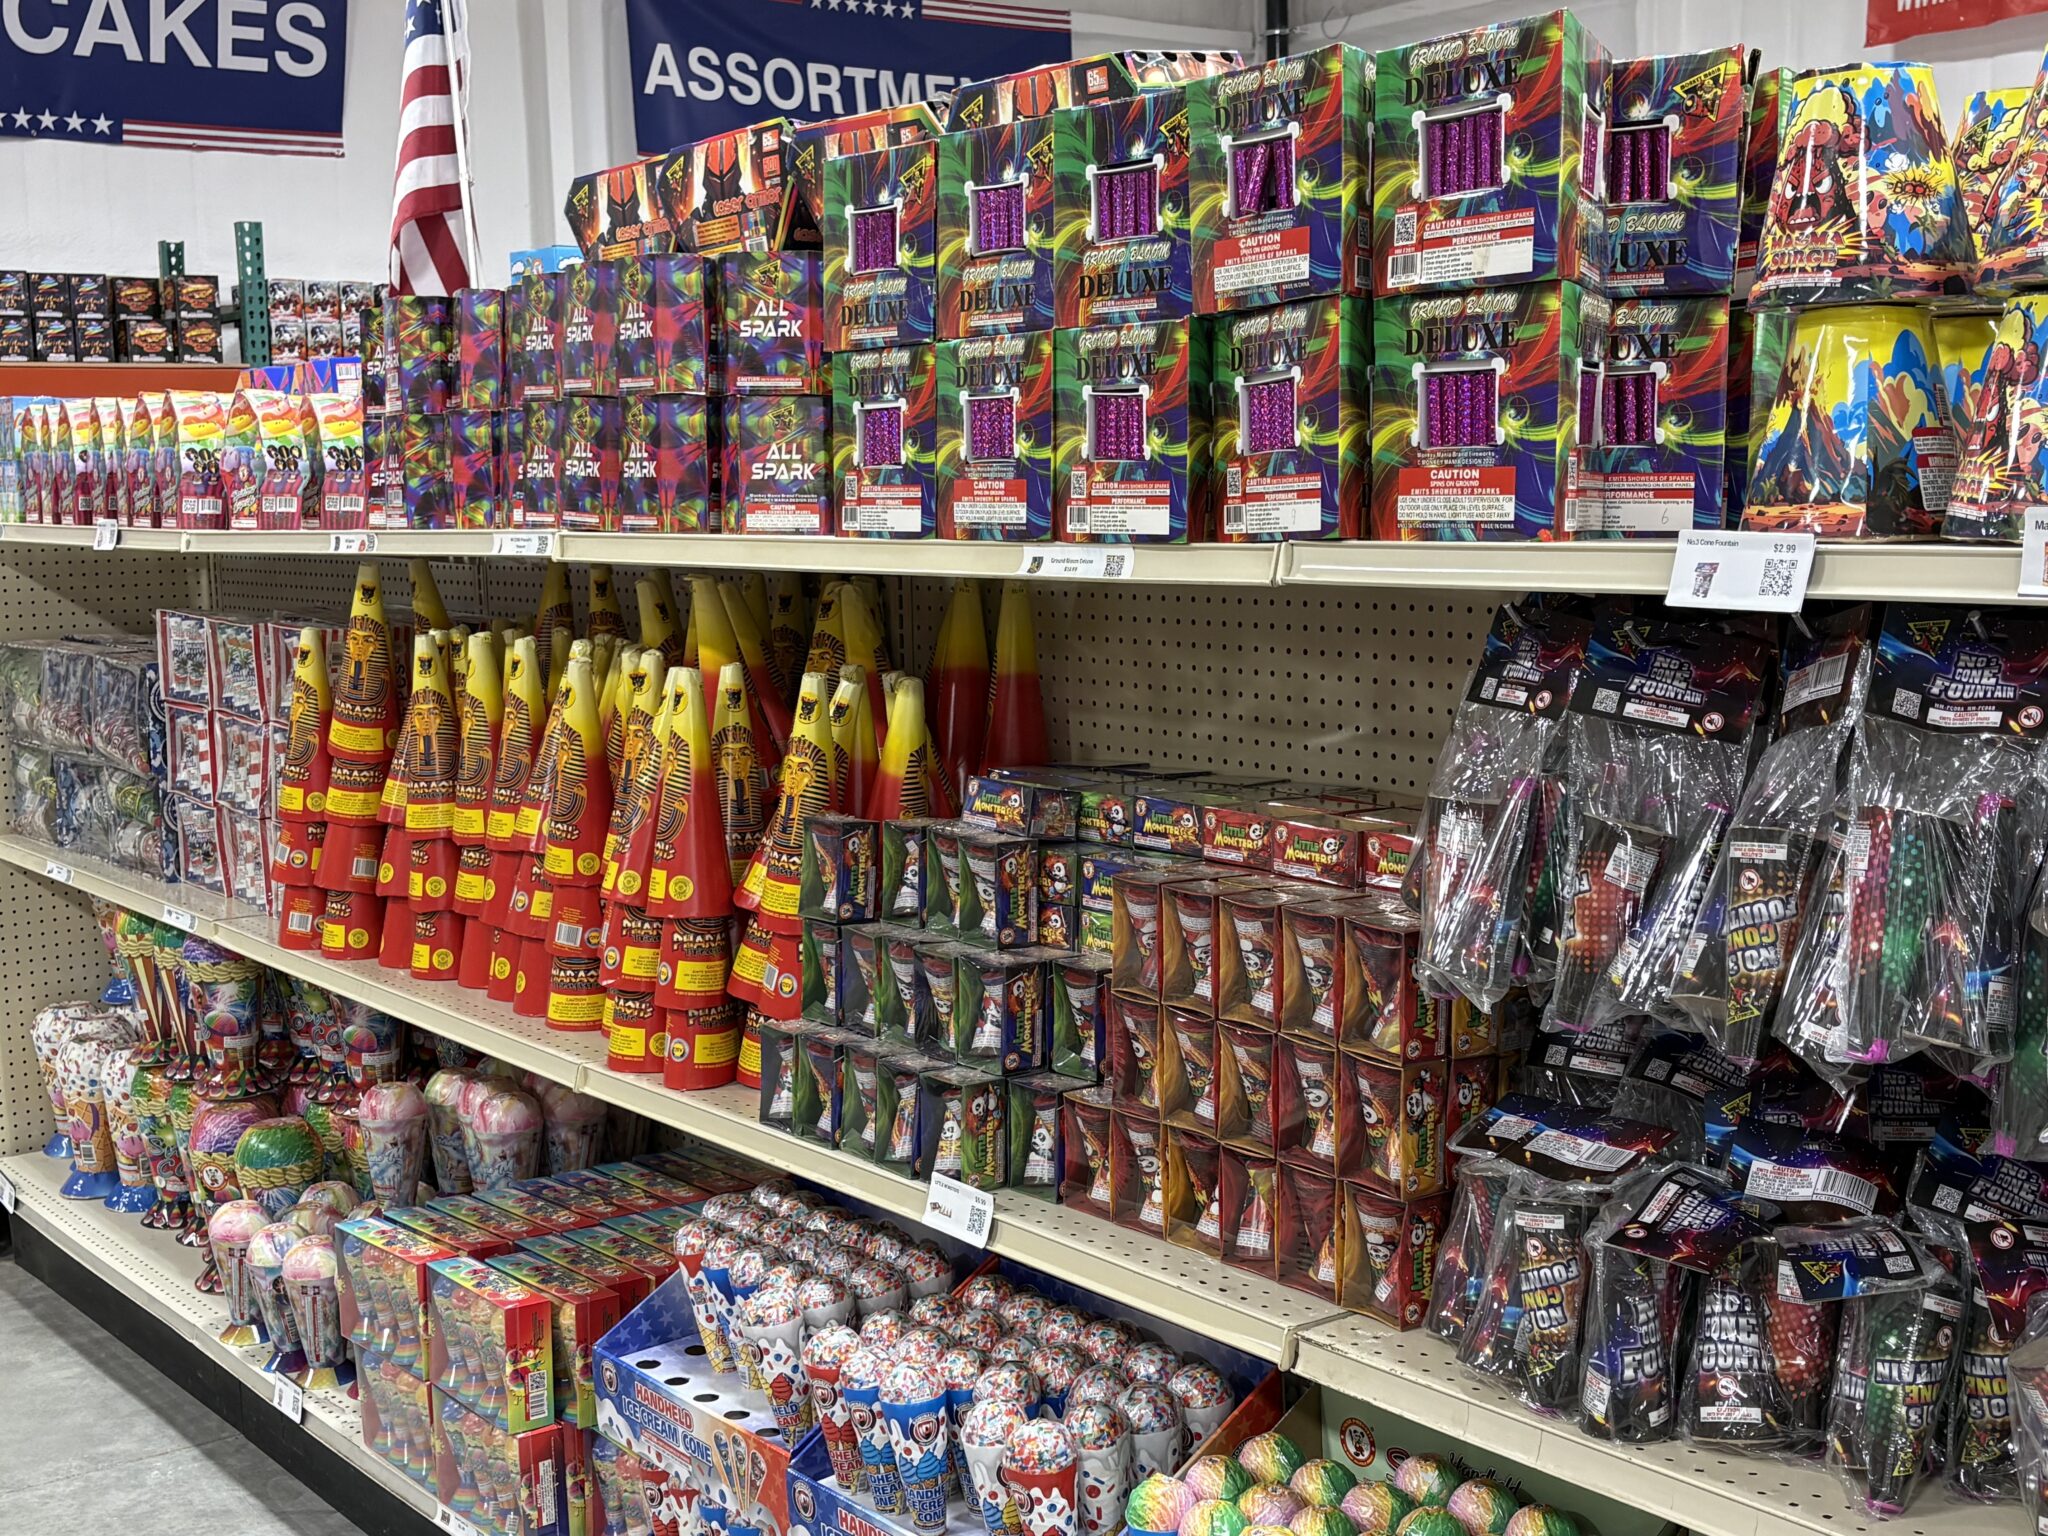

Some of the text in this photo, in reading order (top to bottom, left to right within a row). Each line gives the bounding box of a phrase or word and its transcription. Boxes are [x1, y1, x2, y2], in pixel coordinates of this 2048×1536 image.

[2, 0, 329, 79] CAKES
[1410, 29, 1520, 74] GROUND BLOOM
[1217, 59, 1305, 101] GROUND BLOOM
[1404, 56, 1522, 107] DELUXE
[1215, 87, 1309, 131] DELUXE
[1424, 218, 1462, 232] CAUTION
[1512, 210, 1534, 219] SPARKS
[1626, 211, 1686, 233] BLOOM
[1239, 232, 1281, 249] CAUTION
[1452, 231, 1501, 246] PERFORMANCE
[1770, 249, 1838, 269] SURGE
[1079, 266, 1172, 299] DELUXE
[754, 299, 790, 317] ALL
[959, 284, 1036, 313] DELUXE
[1410, 293, 1519, 322] GROUND BLOOM
[571, 307, 589, 323] ALL
[625, 301, 646, 320] ALL
[841, 301, 909, 326] DELUXE
[1615, 306, 1678, 326] BLOOM
[531, 315, 548, 333] ALL
[619, 319, 653, 341] SPARK
[739, 319, 802, 338] SPARK
[525, 332, 555, 352] SPARK
[566, 324, 594, 344] SPARK
[1404, 319, 1520, 358] DELUXE
[1230, 335, 1310, 373] DELUXE
[956, 361, 1029, 388] DELUXE
[1077, 352, 1160, 381] DELUXE
[849, 370, 913, 396] DELUXE
[532, 445, 549, 461] ALL
[572, 441, 593, 458] ALL
[630, 441, 649, 458] ALL
[766, 442, 803, 460] ALL
[526, 462, 555, 479] SPARK
[565, 460, 600, 478] SPARK
[623, 460, 657, 479] SPARK
[750, 462, 817, 480] SPARK
[1430, 469, 1480, 480] CAUTION
[973, 480, 1005, 490] CAUTION
[1091, 481, 1119, 489] CAUTION
[1246, 477, 1271, 486] CAUTION
[1429, 480, 1480, 488] SPINS ON GROUND
[1410, 488, 1430, 496] EMITS
[1431, 488, 1462, 496] SHOWERS
[1473, 487, 1501, 495] SPARKS
[1111, 497, 1147, 506] PERFORMANCE
[1661, 508, 1669, 526] 6
[1700, 539, 1715, 547] Cone
[1715, 539, 1740, 548] Fountain
[1773, 543, 1797, 554] $2.99
[1654, 653, 1681, 669] NO
[1957, 653, 1986, 669] NO
[1650, 668, 1691, 690] CONE
[1954, 667, 1999, 686] CONE
[1628, 676, 1704, 705] FOUNTAIN
[1930, 676, 2015, 701] FOUNTAIN
[1222, 821, 1246, 838] LITTLE
[1214, 833, 1262, 850] MONSTERS
[1293, 835, 1319, 853] LITTLE
[1284, 845, 1336, 865] MONSTERS
[1870, 1100, 1941, 1115] FOUNTAIN
[984, 1116, 995, 1177] MONSTERS
[1424, 1103, 1436, 1178] MONSTERS
[975, 1134, 986, 1172] LITTLE
[1772, 1164, 1802, 1174] CAUTION
[1996, 1173, 2039, 1201] CONE
[1705, 1314, 1759, 1346] CONE
[634, 1381, 694, 1432] HANDHELD
[622, 1396, 713, 1466] ICE CREAM CONE
